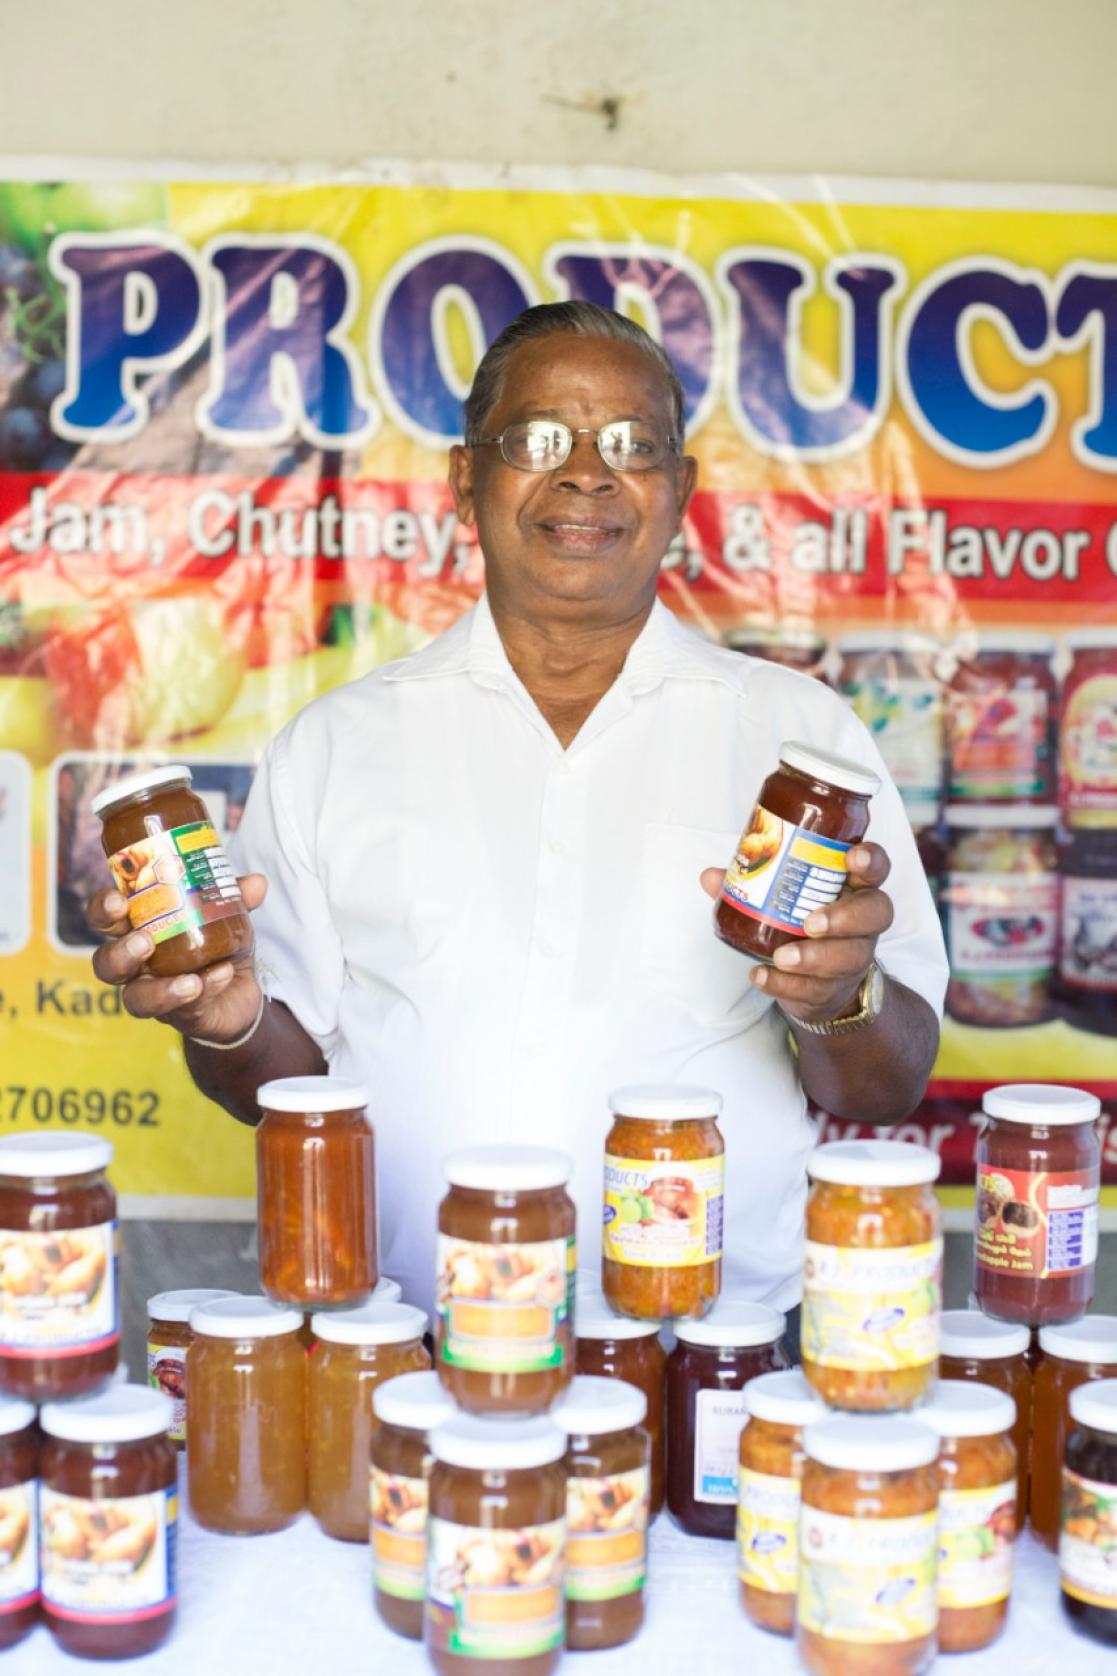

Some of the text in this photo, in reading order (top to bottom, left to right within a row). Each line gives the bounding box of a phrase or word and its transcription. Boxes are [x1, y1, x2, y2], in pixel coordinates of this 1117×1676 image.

[8, 487, 167, 567] Jam,
[189, 491, 471, 578] Chutney,
[722, 503, 773, 572] &
[791, 510, 867, 574] all
[887, 510, 1091, 581] Flavor
[0, 1085, 161, 1127] 706962
